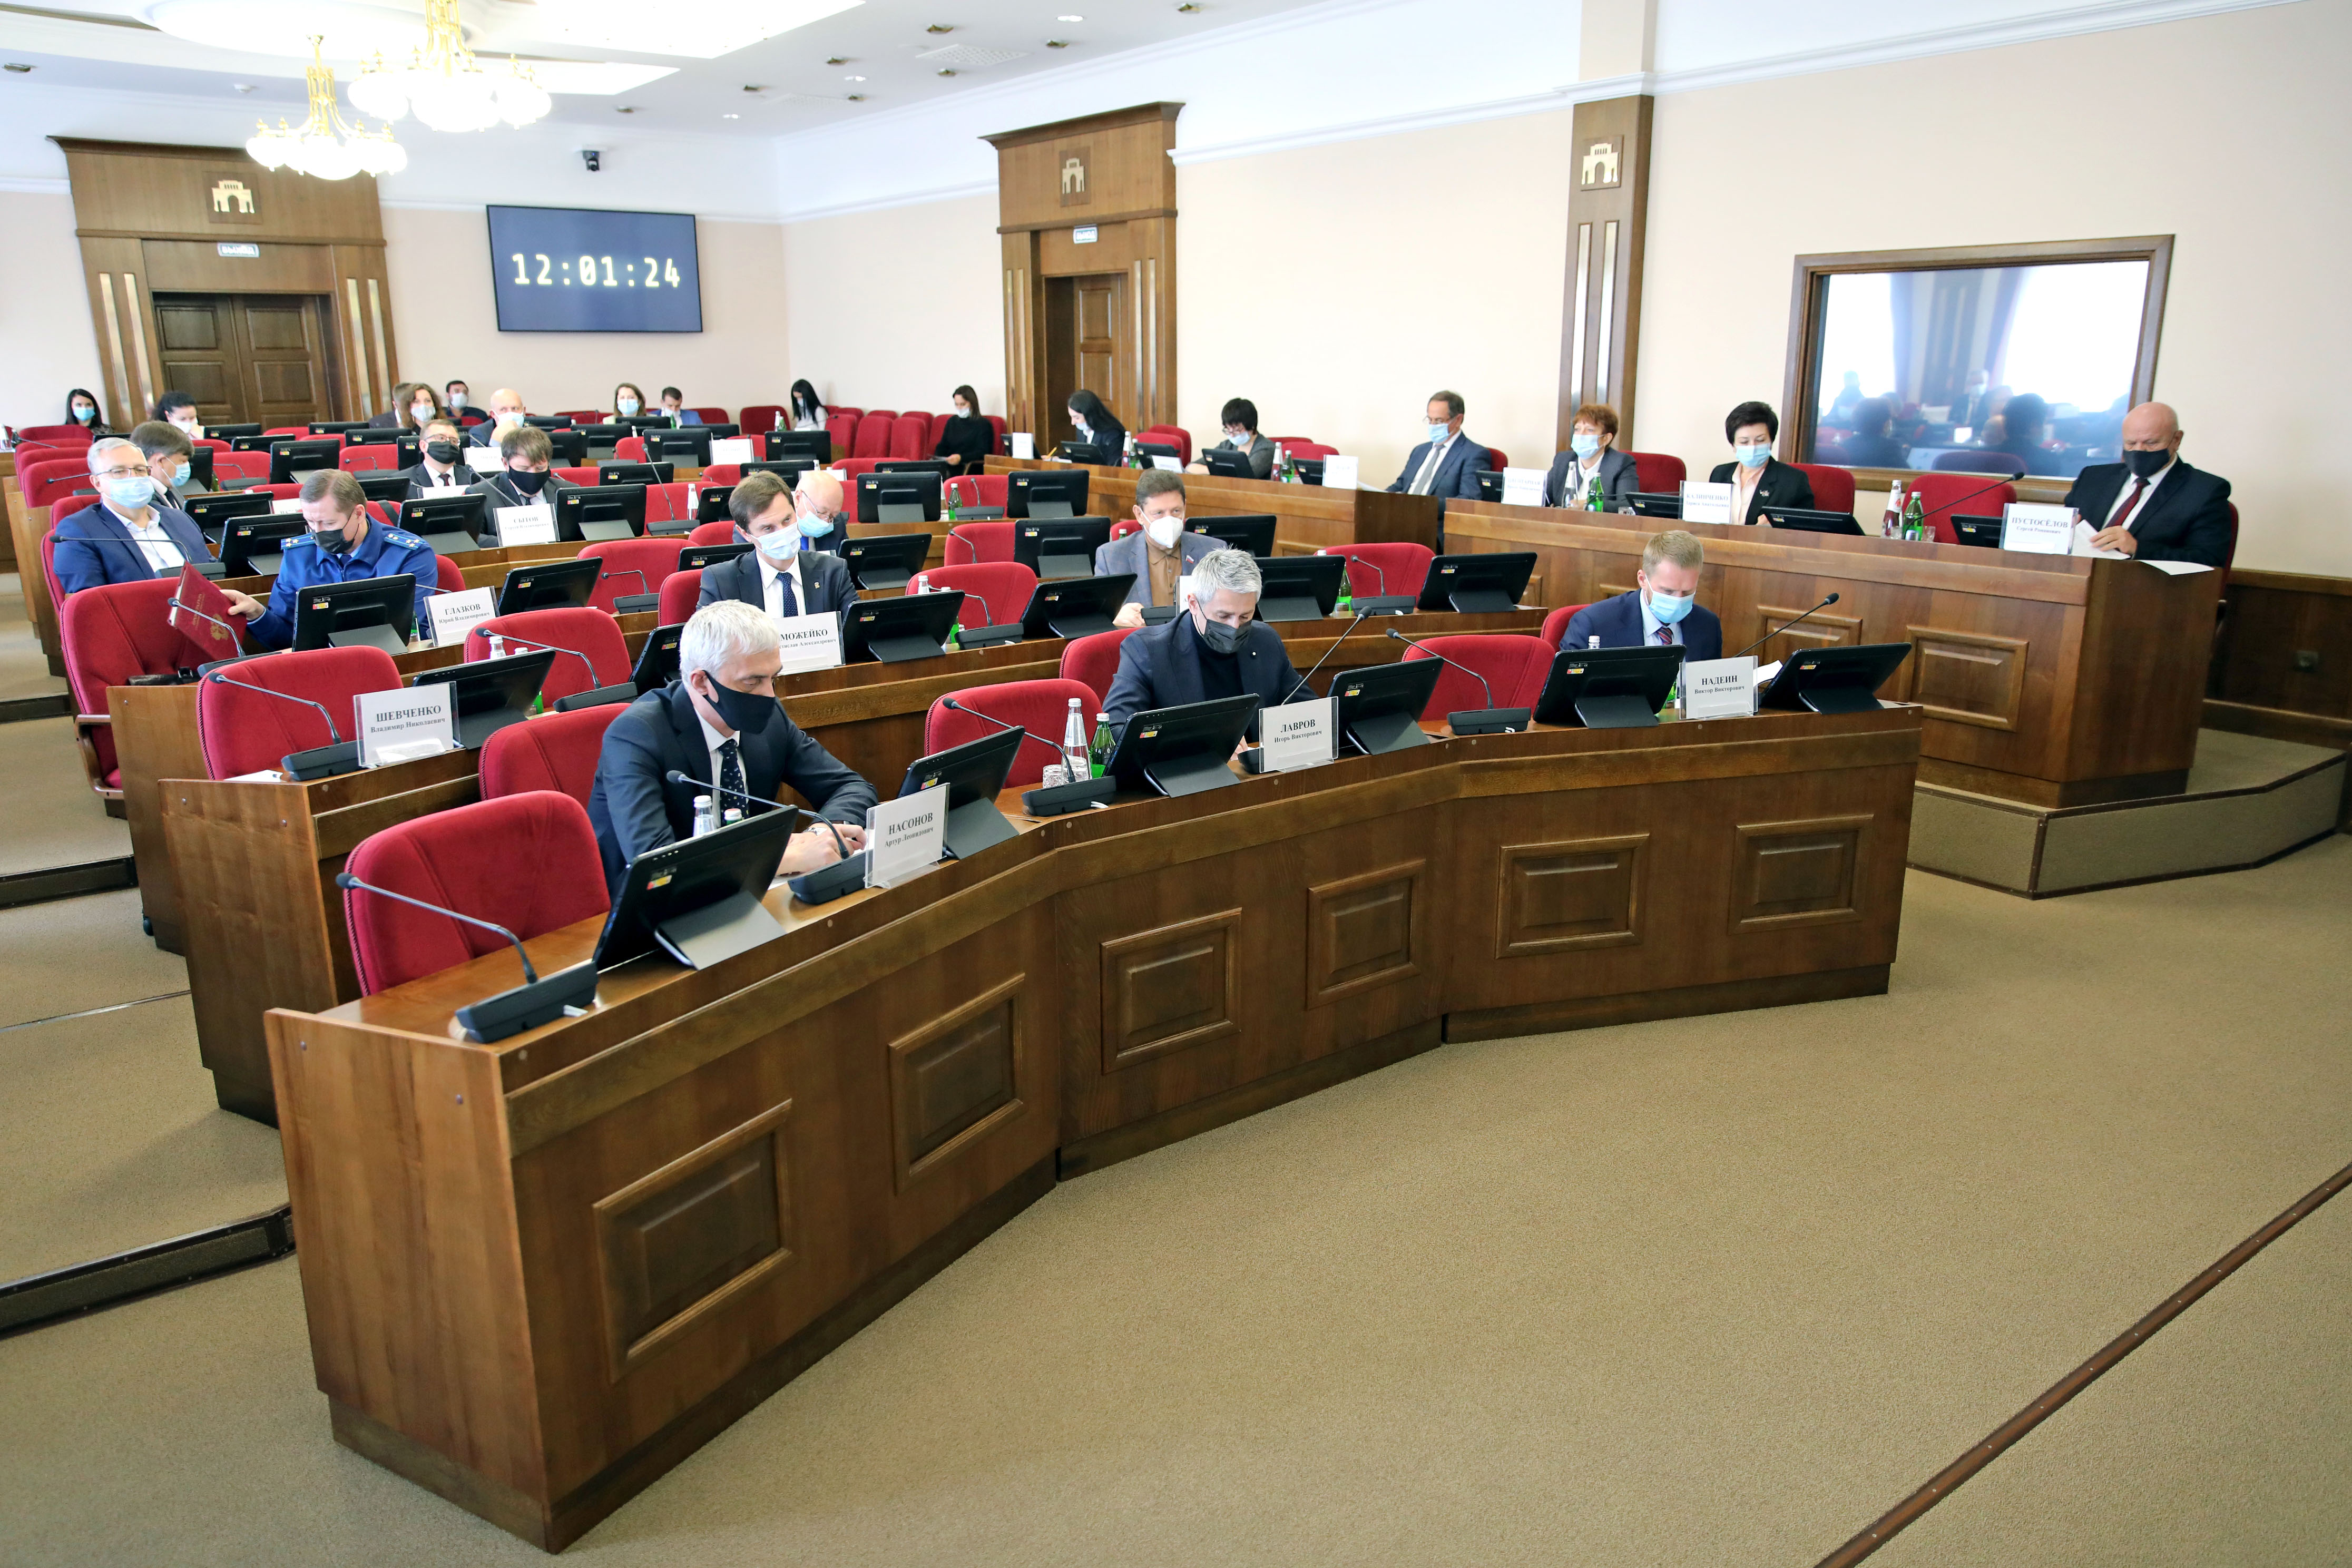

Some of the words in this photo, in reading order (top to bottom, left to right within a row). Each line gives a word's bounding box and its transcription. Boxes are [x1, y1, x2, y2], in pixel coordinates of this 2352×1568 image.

[512, 253, 680, 288] 12:01:24
[2012, 517, 2068, 528] ПУСТОСЁЛОВ
[445, 603, 481, 615] ГЛАЗКОВ
[455, 612, 490, 621] Владимирович
[780, 629, 828, 641] МОЖЕЙКО
[799, 638, 836, 646] Александрович
[1701, 675, 1737, 685] НАДЕИН
[376, 705, 442, 722] ШЕВЧЕНКО
[370, 724, 405, 733] Владимир
[406, 718, 446, 728] Николаевич
[1280, 719, 1316, 733] ЛАВРОВ
[1291, 730, 1322, 740] Викторович
[889, 812, 933, 835] НАСОНОВ
[885, 837, 901, 847] Артур
[902, 827, 934, 841] Леонидович
